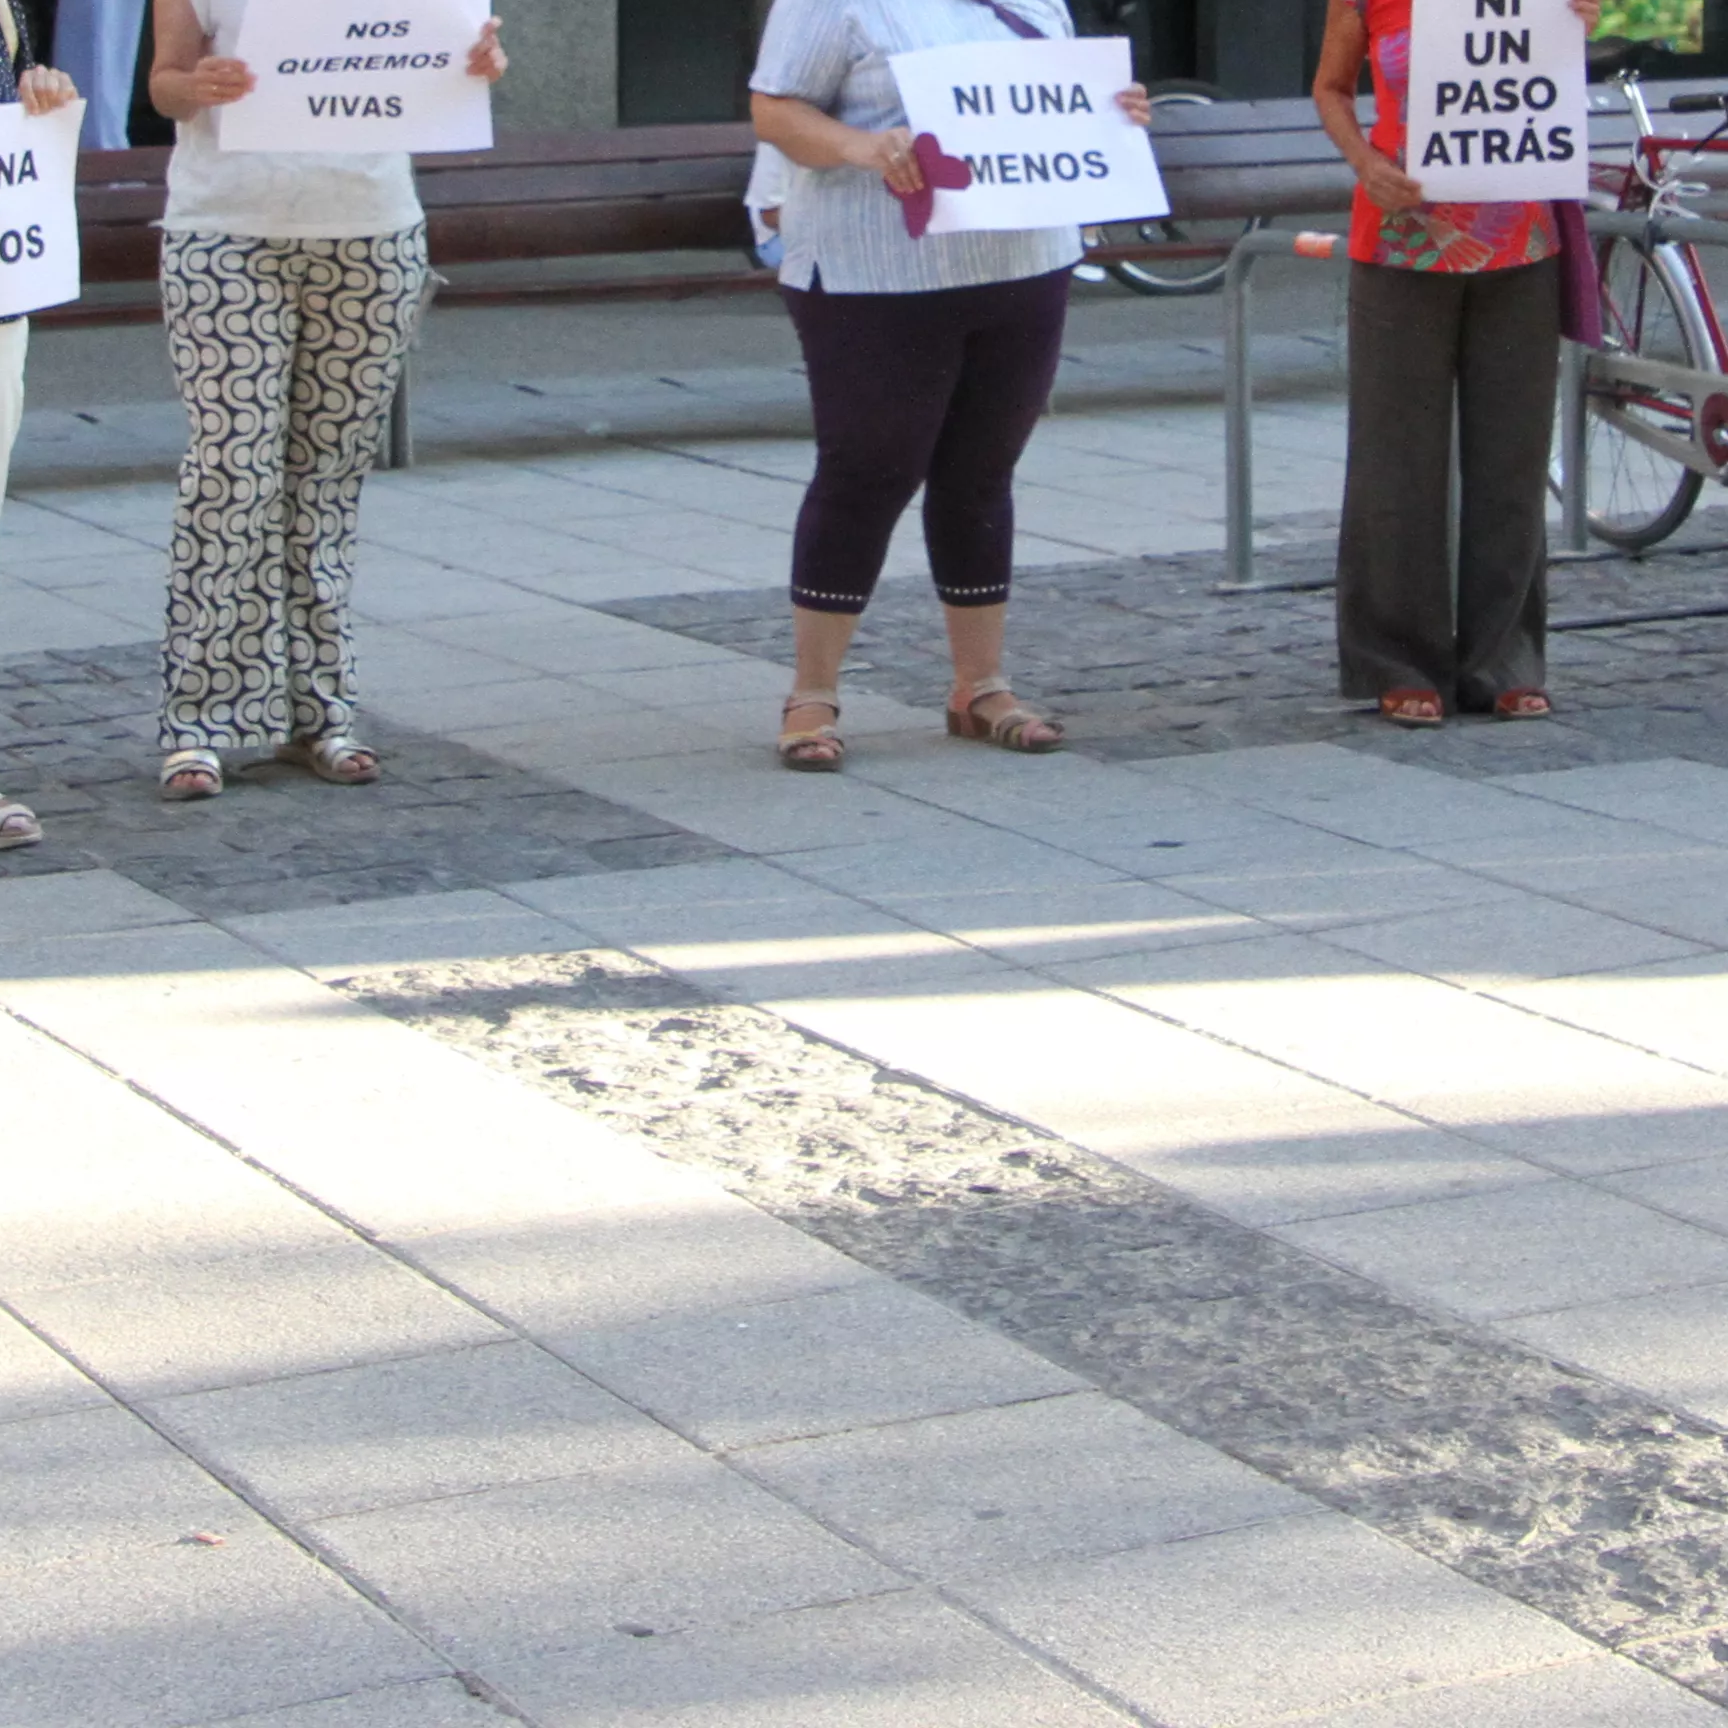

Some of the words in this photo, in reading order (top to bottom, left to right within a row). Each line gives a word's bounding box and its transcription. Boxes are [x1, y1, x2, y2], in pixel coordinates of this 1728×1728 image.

[345, 20, 411, 40] NOS
[1464, 29, 1530, 66] UN
[277, 52, 451, 75] QUEREMOS
[307, 95, 404, 119] VIVAS
[952, 84, 995, 115] NI
[1010, 82, 1094, 115] UNA
[1435, 76, 1557, 117] PASO
[1421, 117, 1574, 168] ATRÁS
[963, 149, 1110, 186] MENOS
